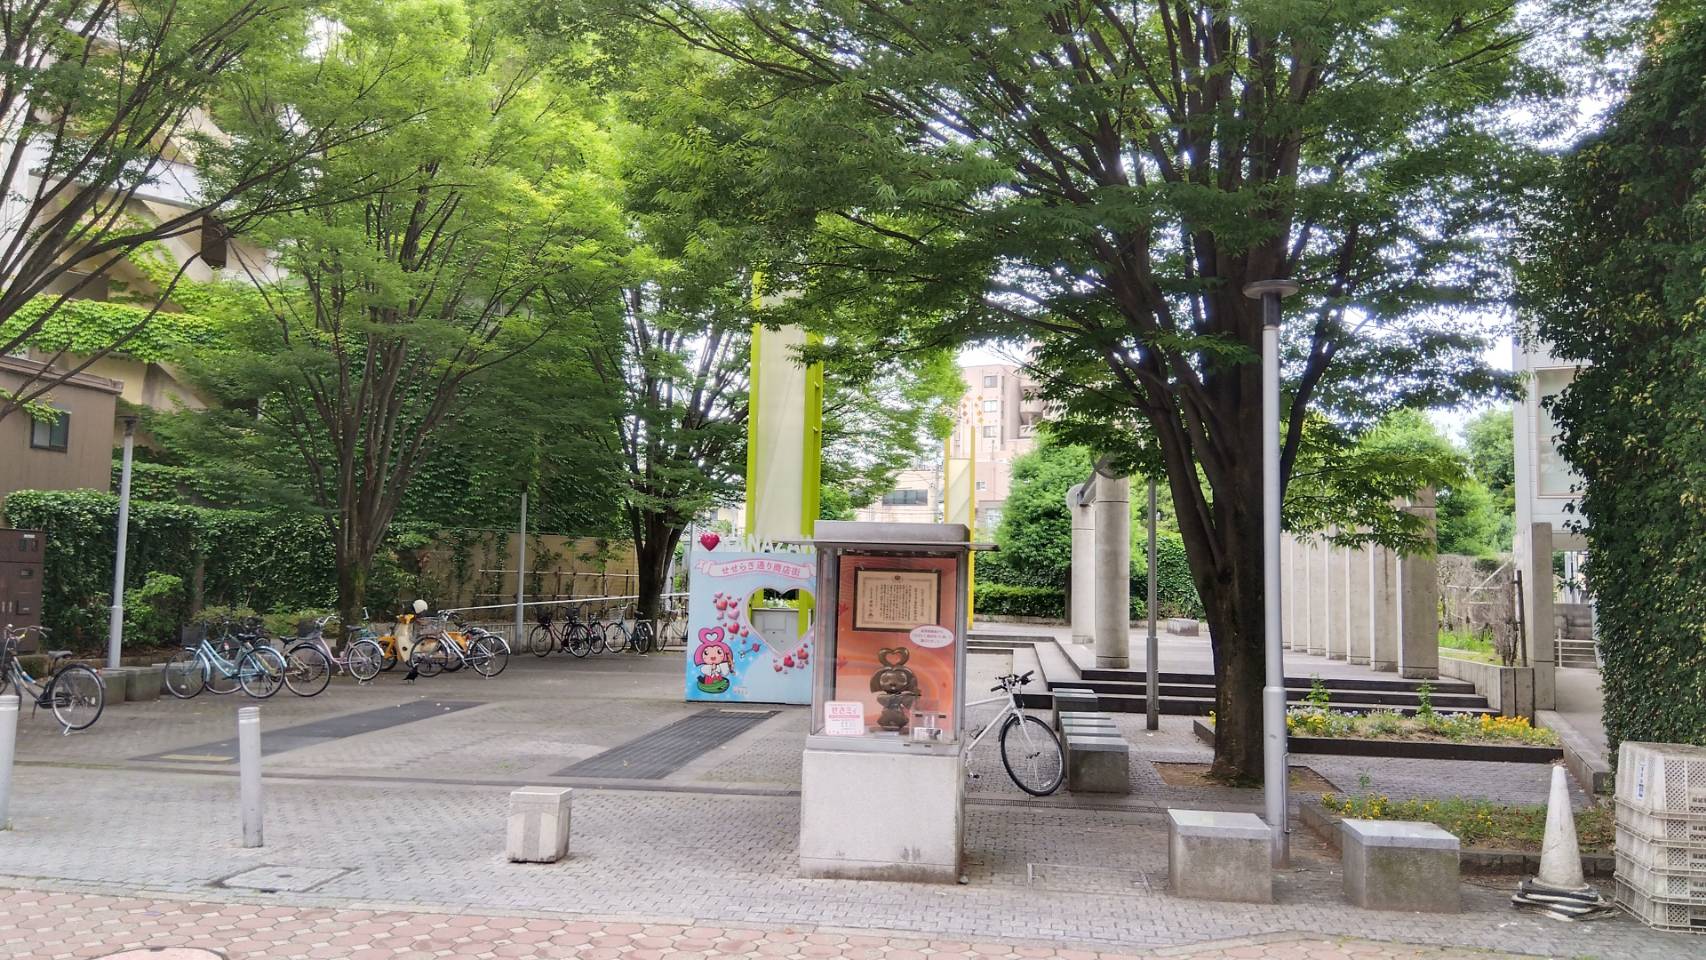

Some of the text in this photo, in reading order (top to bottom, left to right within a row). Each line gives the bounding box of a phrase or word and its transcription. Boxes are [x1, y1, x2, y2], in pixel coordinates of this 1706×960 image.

[721, 561, 801, 577] せせらぎ通り商店街
